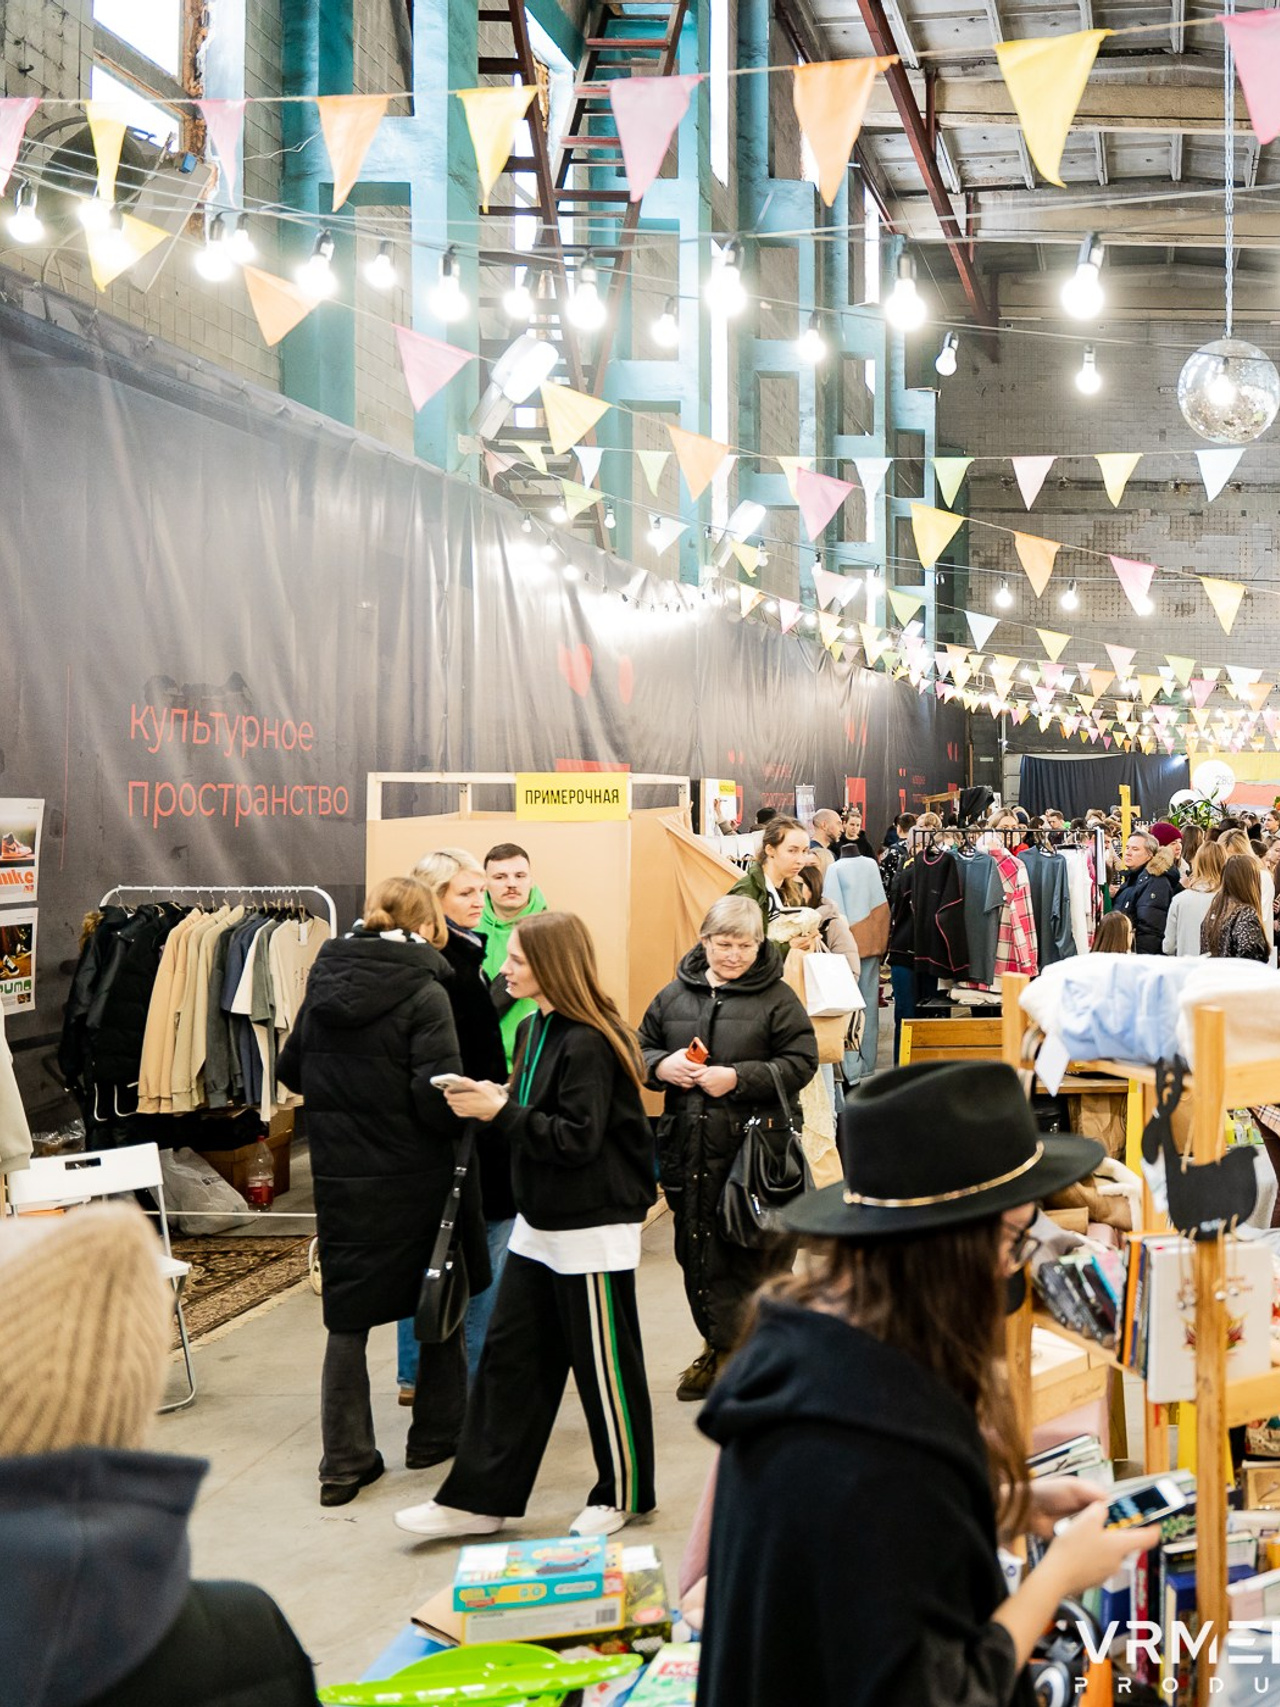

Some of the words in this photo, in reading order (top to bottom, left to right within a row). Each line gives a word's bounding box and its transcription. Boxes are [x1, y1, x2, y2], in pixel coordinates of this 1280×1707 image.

[130, 703, 314, 758] культурное
[128, 781, 349, 829] пространство
[525, 789, 619, 804] ПРИМЕРОЧНАЯ
